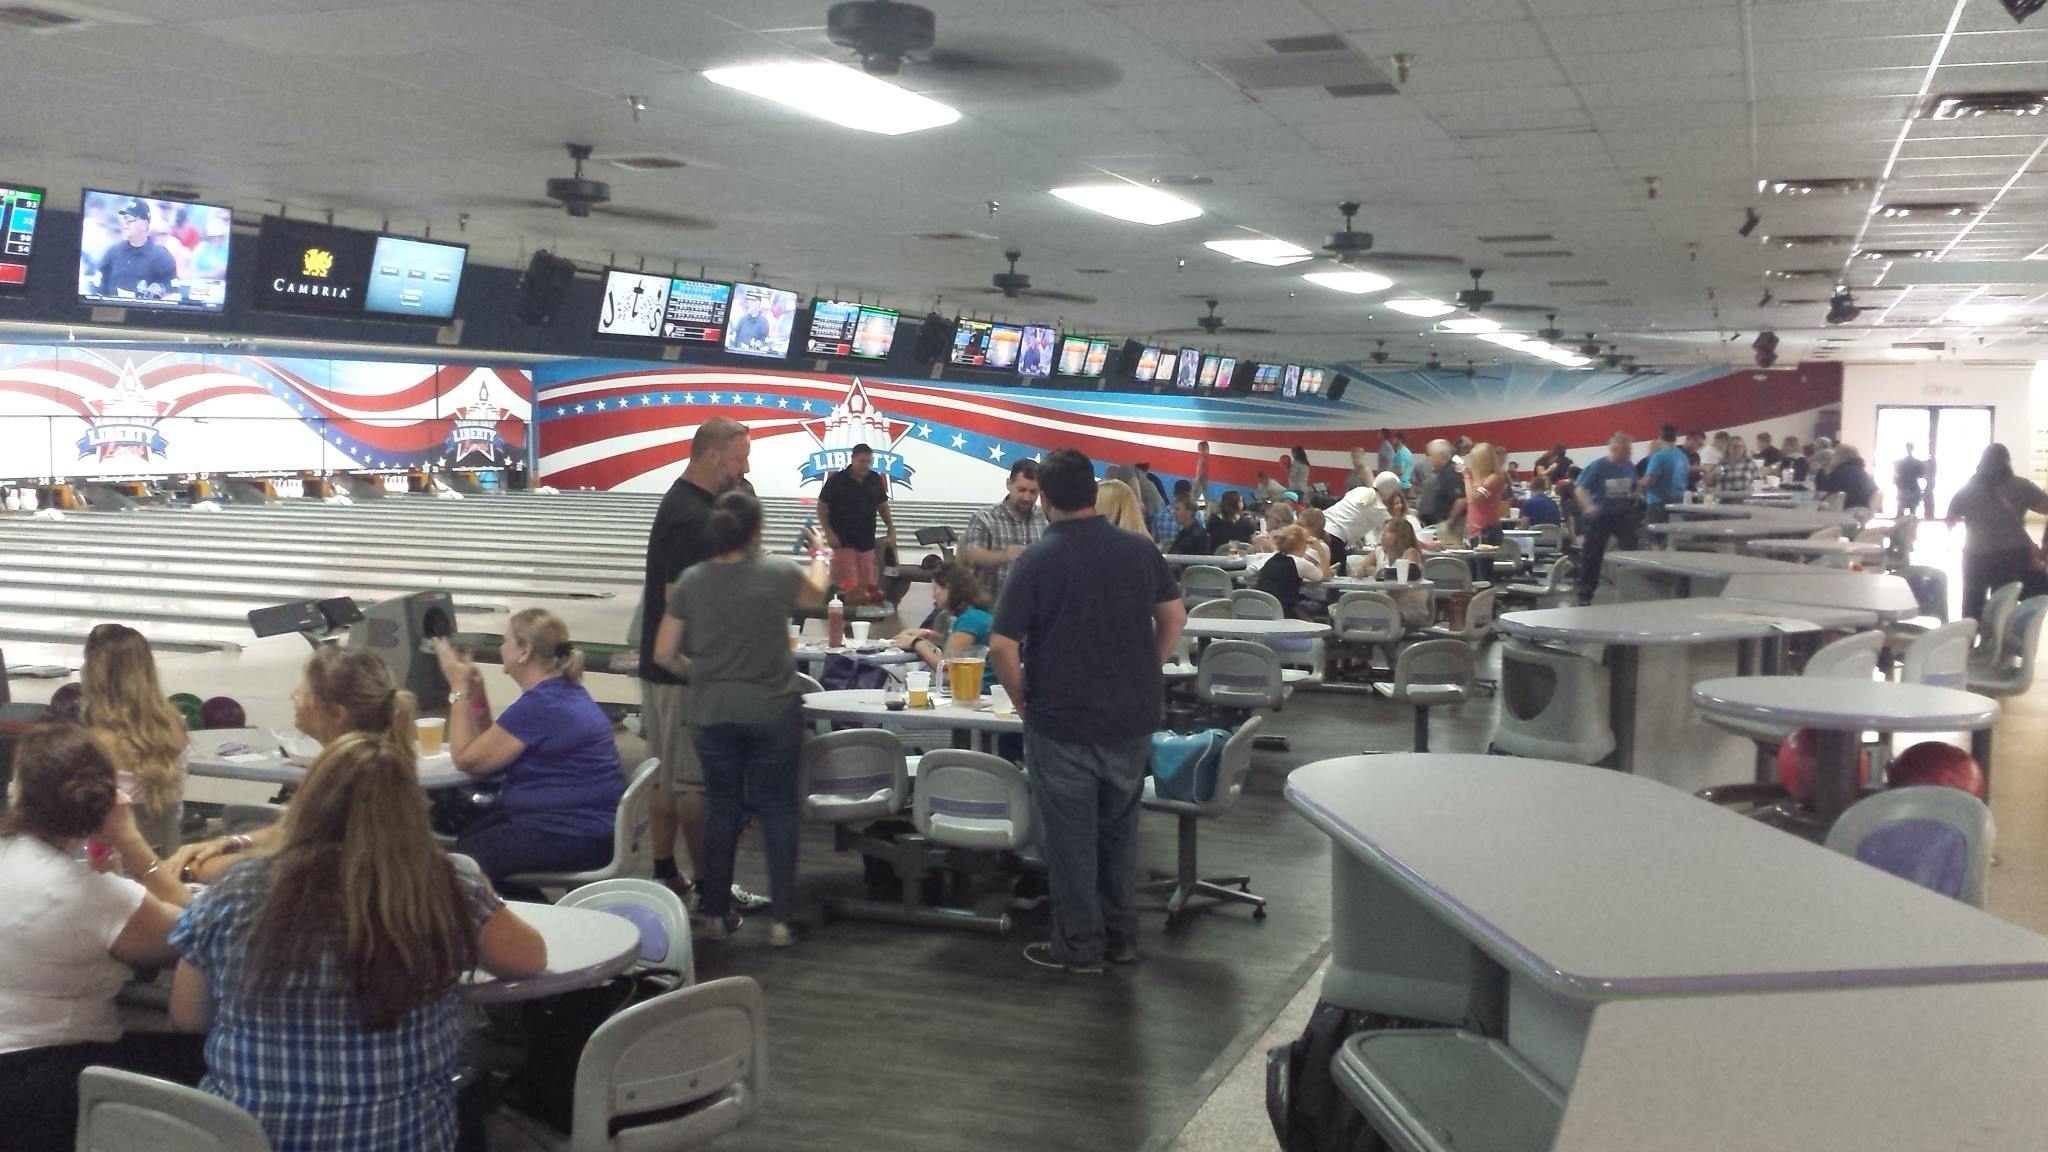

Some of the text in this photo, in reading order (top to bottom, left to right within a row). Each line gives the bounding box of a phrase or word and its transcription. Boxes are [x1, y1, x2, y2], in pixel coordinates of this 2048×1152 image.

[273, 278, 348, 298] CAMBRIA
[452, 427, 497, 443] LIBERTY
[813, 451, 898, 471] LIBTY
